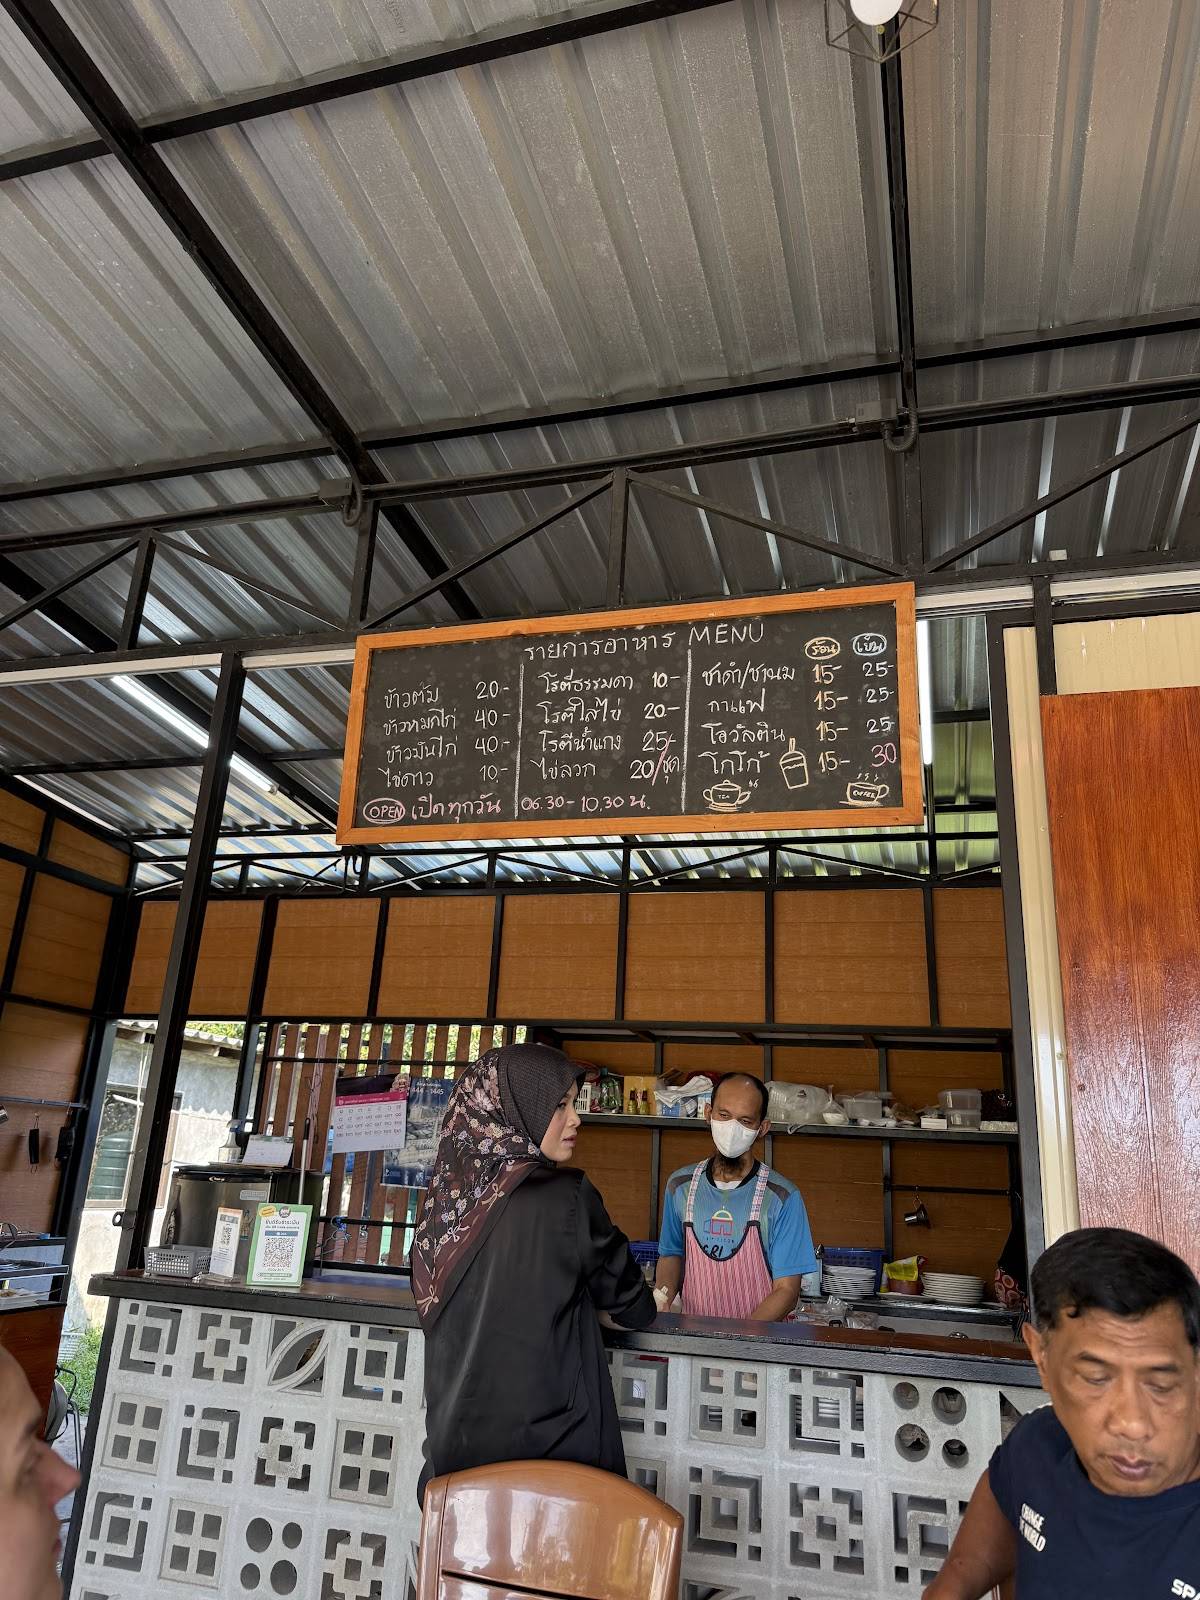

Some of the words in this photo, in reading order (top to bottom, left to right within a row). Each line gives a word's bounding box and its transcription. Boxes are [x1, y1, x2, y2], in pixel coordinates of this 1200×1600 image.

[524, 632, 676, 660] รายการอาหาร
[689, 623, 764, 645] MENU
[812, 641, 838, 655] ร้อน
[702, 660, 795, 689] ชาดำ/ชานม
[384, 684, 439, 708] ข้าวต้ม
[707, 687, 766, 713] กาแฟ
[383, 708, 457, 735] ข้าวหมกไก่
[535, 696, 621, 724] โรตีใส่ไข่
[538, 726, 622, 753] โรตีน้ำแกง
[701, 721, 785, 745] โอวัลติน
[386, 735, 458, 763] ข้าวมันไก่
[871, 743, 897, 768] 30
[378, 767, 434, 788] ไข่ดาว
[530, 757, 596, 780] ไข่ลวก
[369, 805, 404, 819] OPEN
[411, 792, 501, 824] เปิดทุกวัน
[1171, 1578, 1200, 1600] SP
